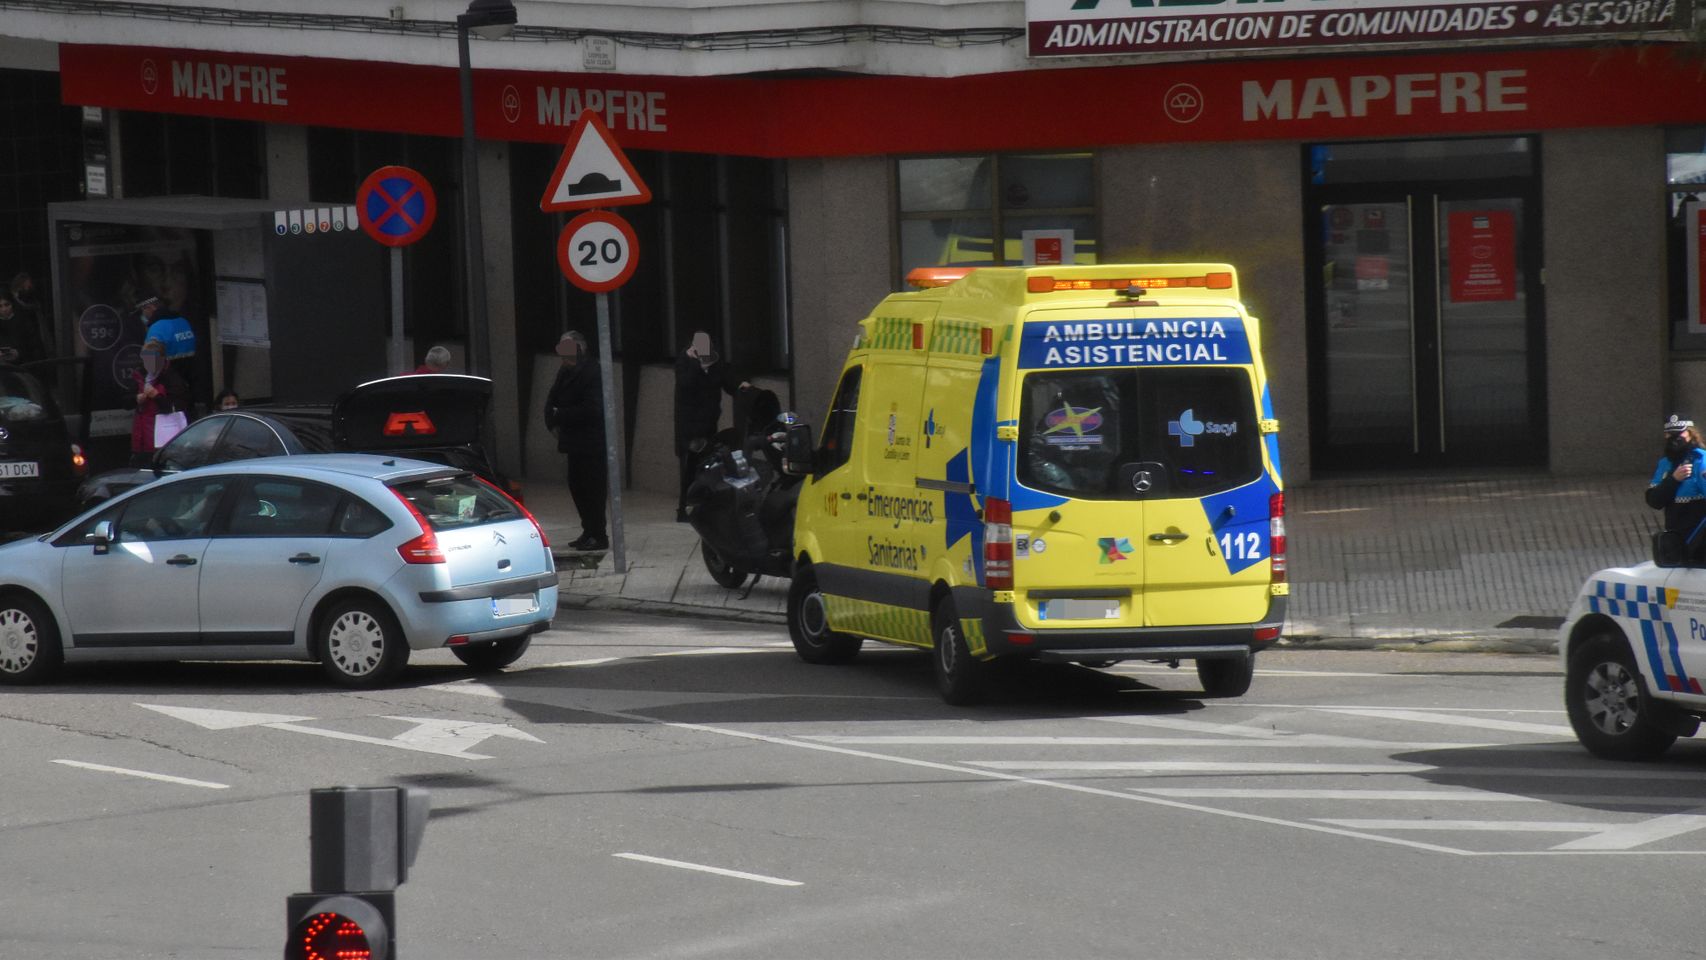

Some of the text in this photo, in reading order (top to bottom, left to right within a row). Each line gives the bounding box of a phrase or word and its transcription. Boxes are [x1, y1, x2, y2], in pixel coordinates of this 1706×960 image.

[1045, 16, 1272, 48] ADMINISTRACION
[1278, 14, 1312, 38] DE
[1319, 5, 1517, 37] COMUNIDADES
[172, 60, 288, 106] MAPFRE
[1242, 69, 1527, 121] MAPFRE
[536, 86, 668, 132] MAPFRE
[578, 238, 622, 266] 20
[1043, 321, 1226, 343] AMBULANCIA
[1044, 343, 1228, 365] ASISTENCIAL
[1206, 421, 1237, 437] Sacyl
[13, 463, 35, 476] DCV
[868, 486, 934, 528] Emergencias
[868, 535, 918, 571] Sanitarias
[1221, 532, 1260, 559] 112
